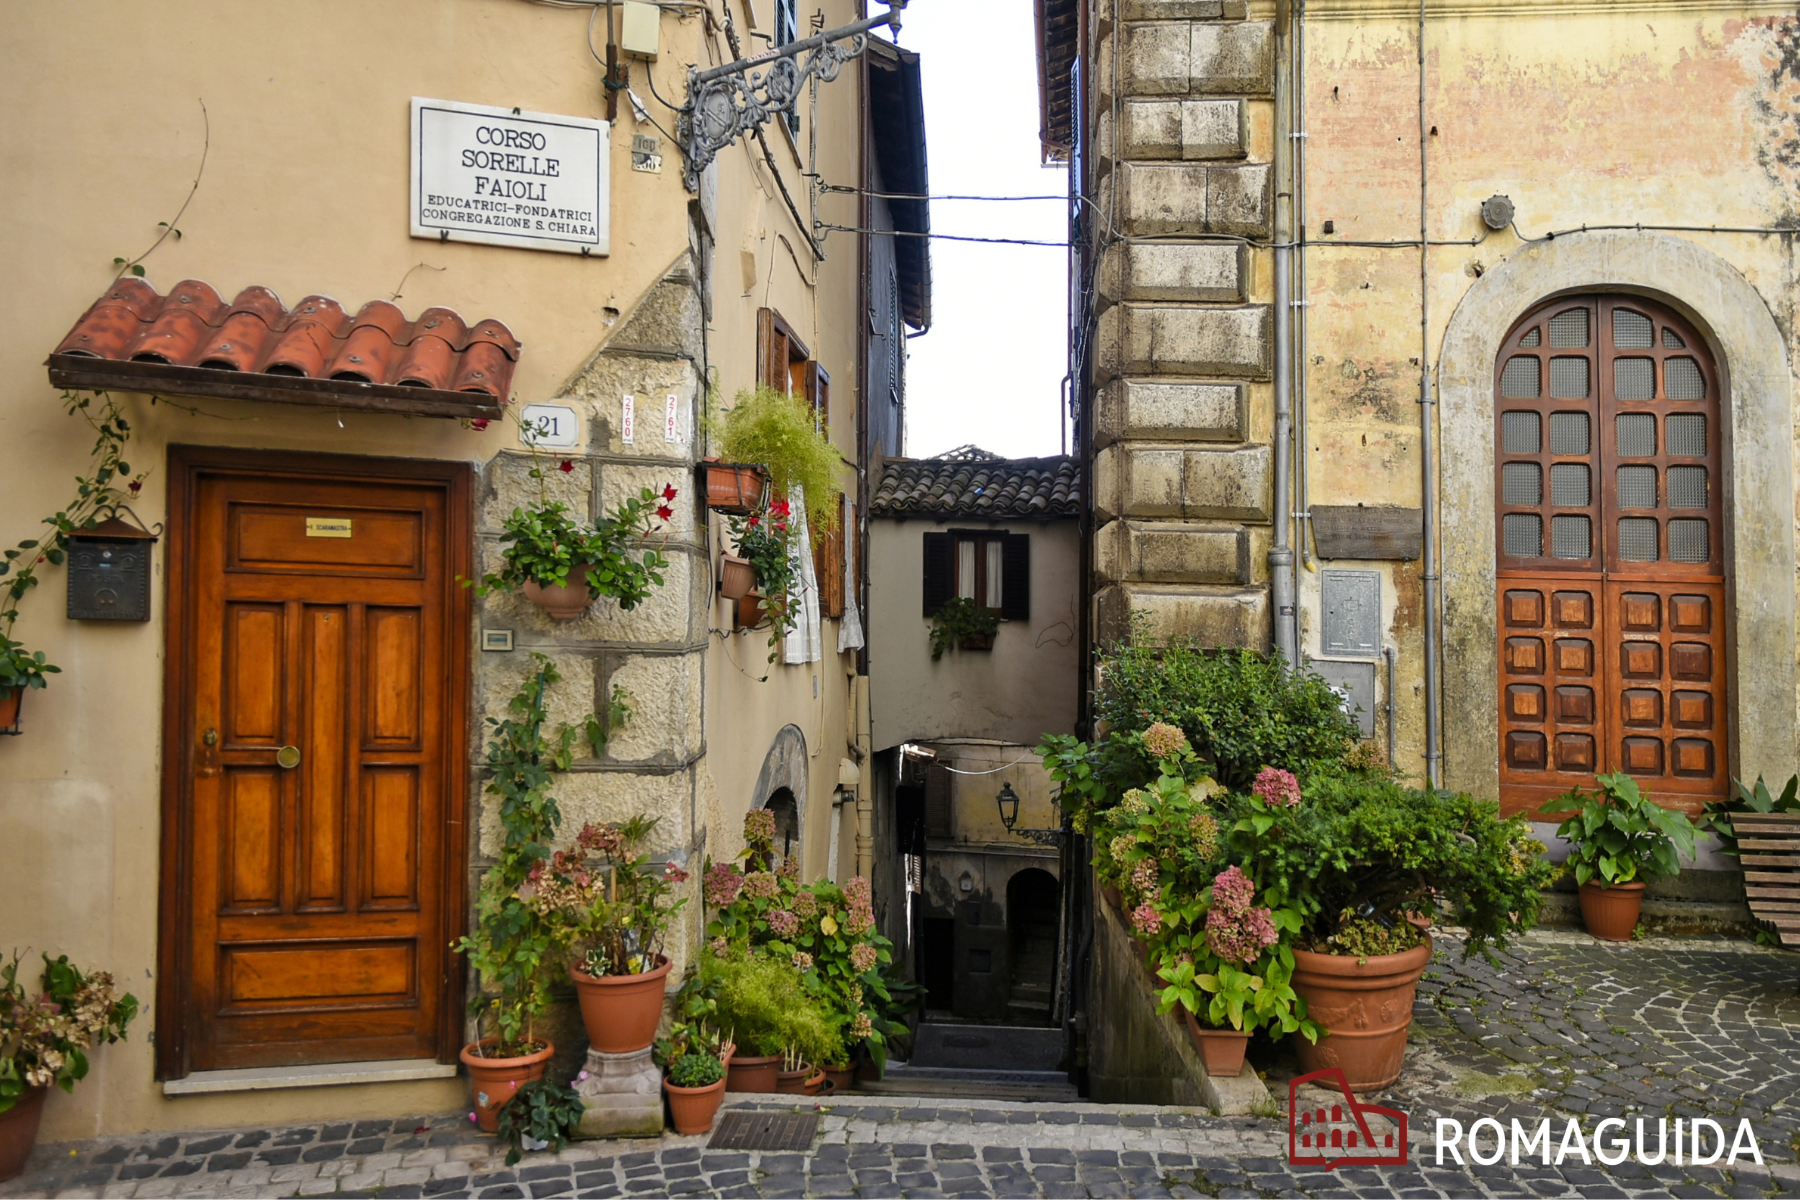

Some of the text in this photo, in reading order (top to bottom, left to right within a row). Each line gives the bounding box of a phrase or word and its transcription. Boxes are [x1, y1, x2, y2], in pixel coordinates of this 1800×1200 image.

[476, 126, 546, 151] CORSO
[462, 149, 560, 177] SORELLE
[475, 176, 547, 201] FAIOLI
[422, 208, 597, 237] CONGREGAZIONE S. CHIARA
[539, 415, 560, 437] 21
